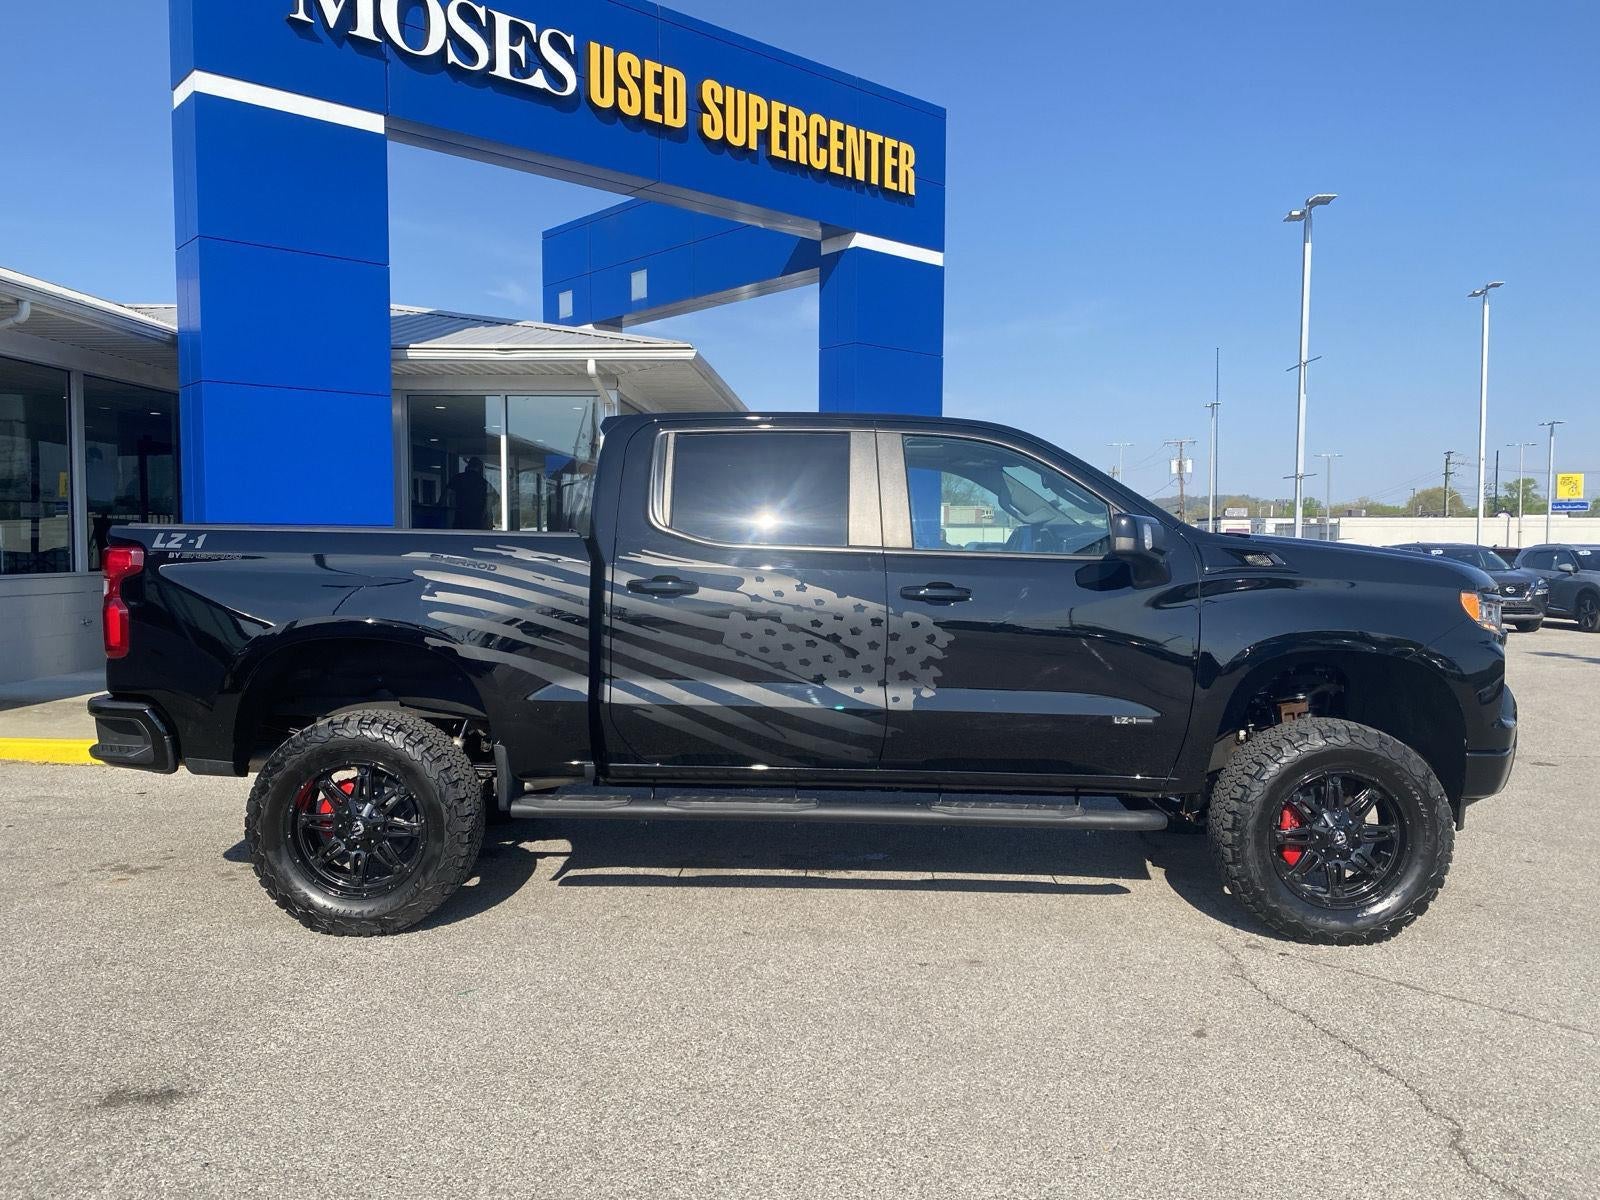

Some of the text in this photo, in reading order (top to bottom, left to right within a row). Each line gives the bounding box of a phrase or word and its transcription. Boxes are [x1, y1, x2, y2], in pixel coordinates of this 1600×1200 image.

[587, 41, 688, 129] USED
[701, 79, 917, 196] SUPERCENTER
[152, 532, 208, 549] LZ-1
[1114, 716, 1137, 724] LZ-1
